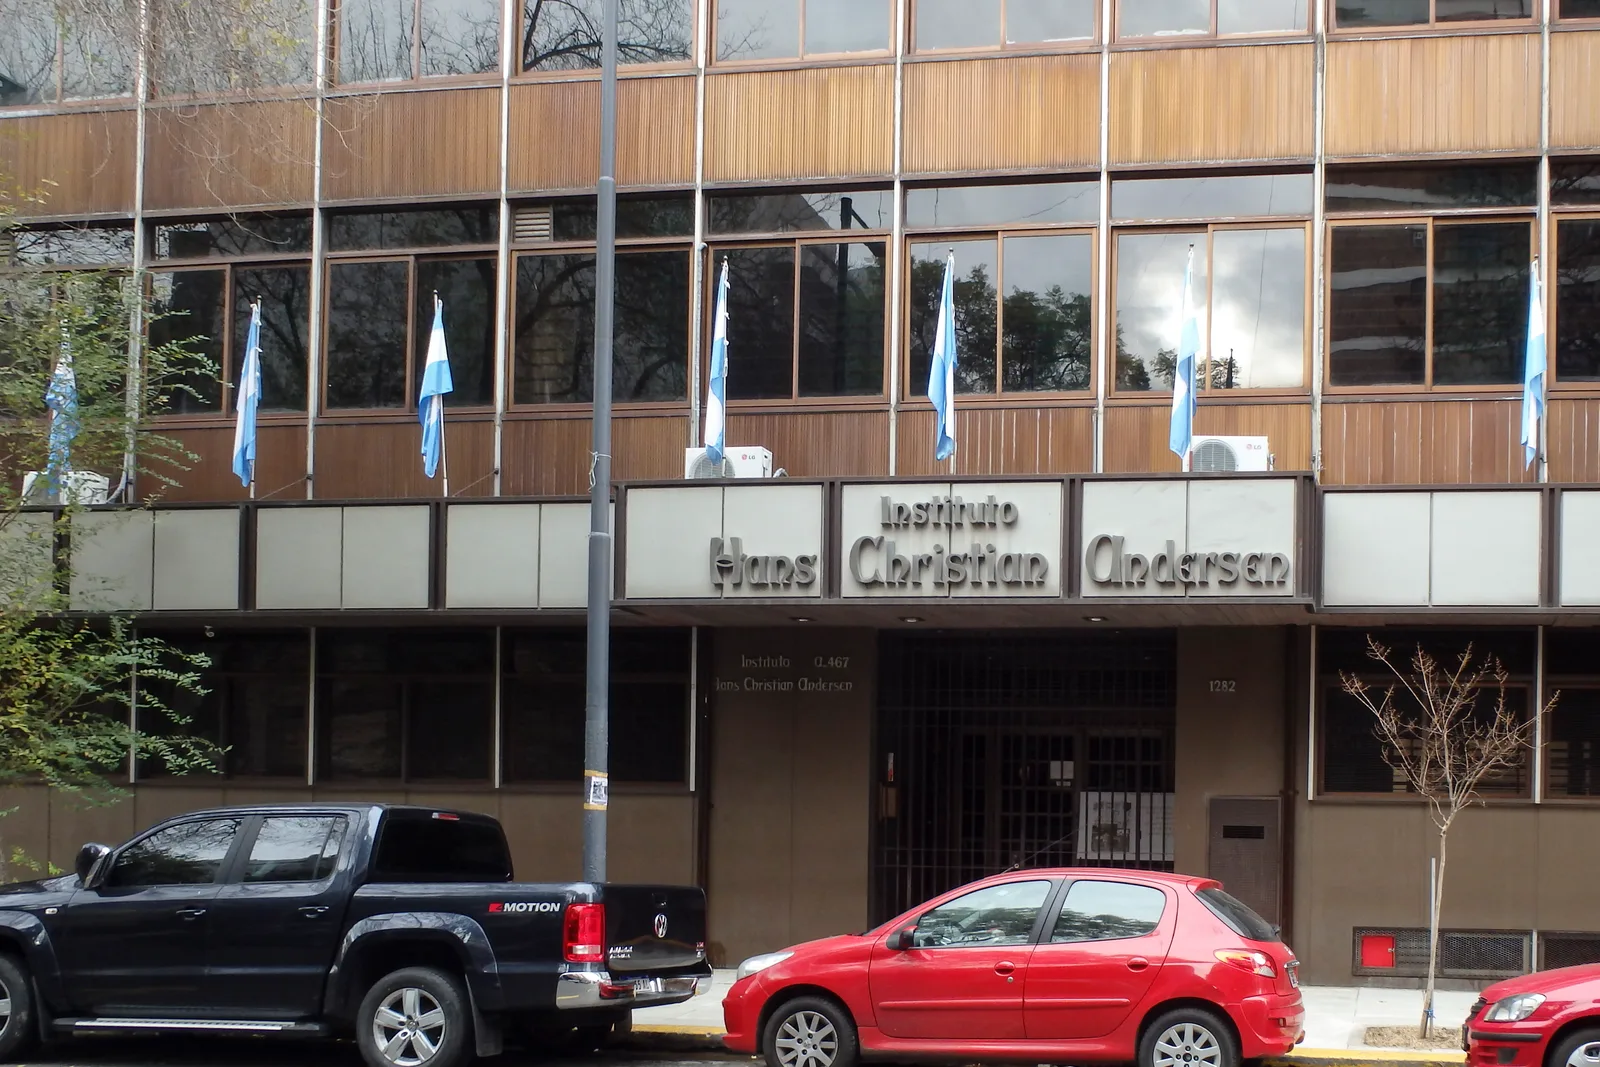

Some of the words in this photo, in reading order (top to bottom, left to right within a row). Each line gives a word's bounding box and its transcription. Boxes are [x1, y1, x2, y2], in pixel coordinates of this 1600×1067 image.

[880, 495, 1019, 527] Instituto
[710, 537, 817, 586] Hans
[849, 535, 1048, 586] Christian
[1085, 533, 1289, 586] Andersen
[741, 654, 791, 668] Instituto
[743, 677, 794, 691] Christian
[798, 677, 853, 691] Andersen
[1209, 680, 1236, 692] 1282
